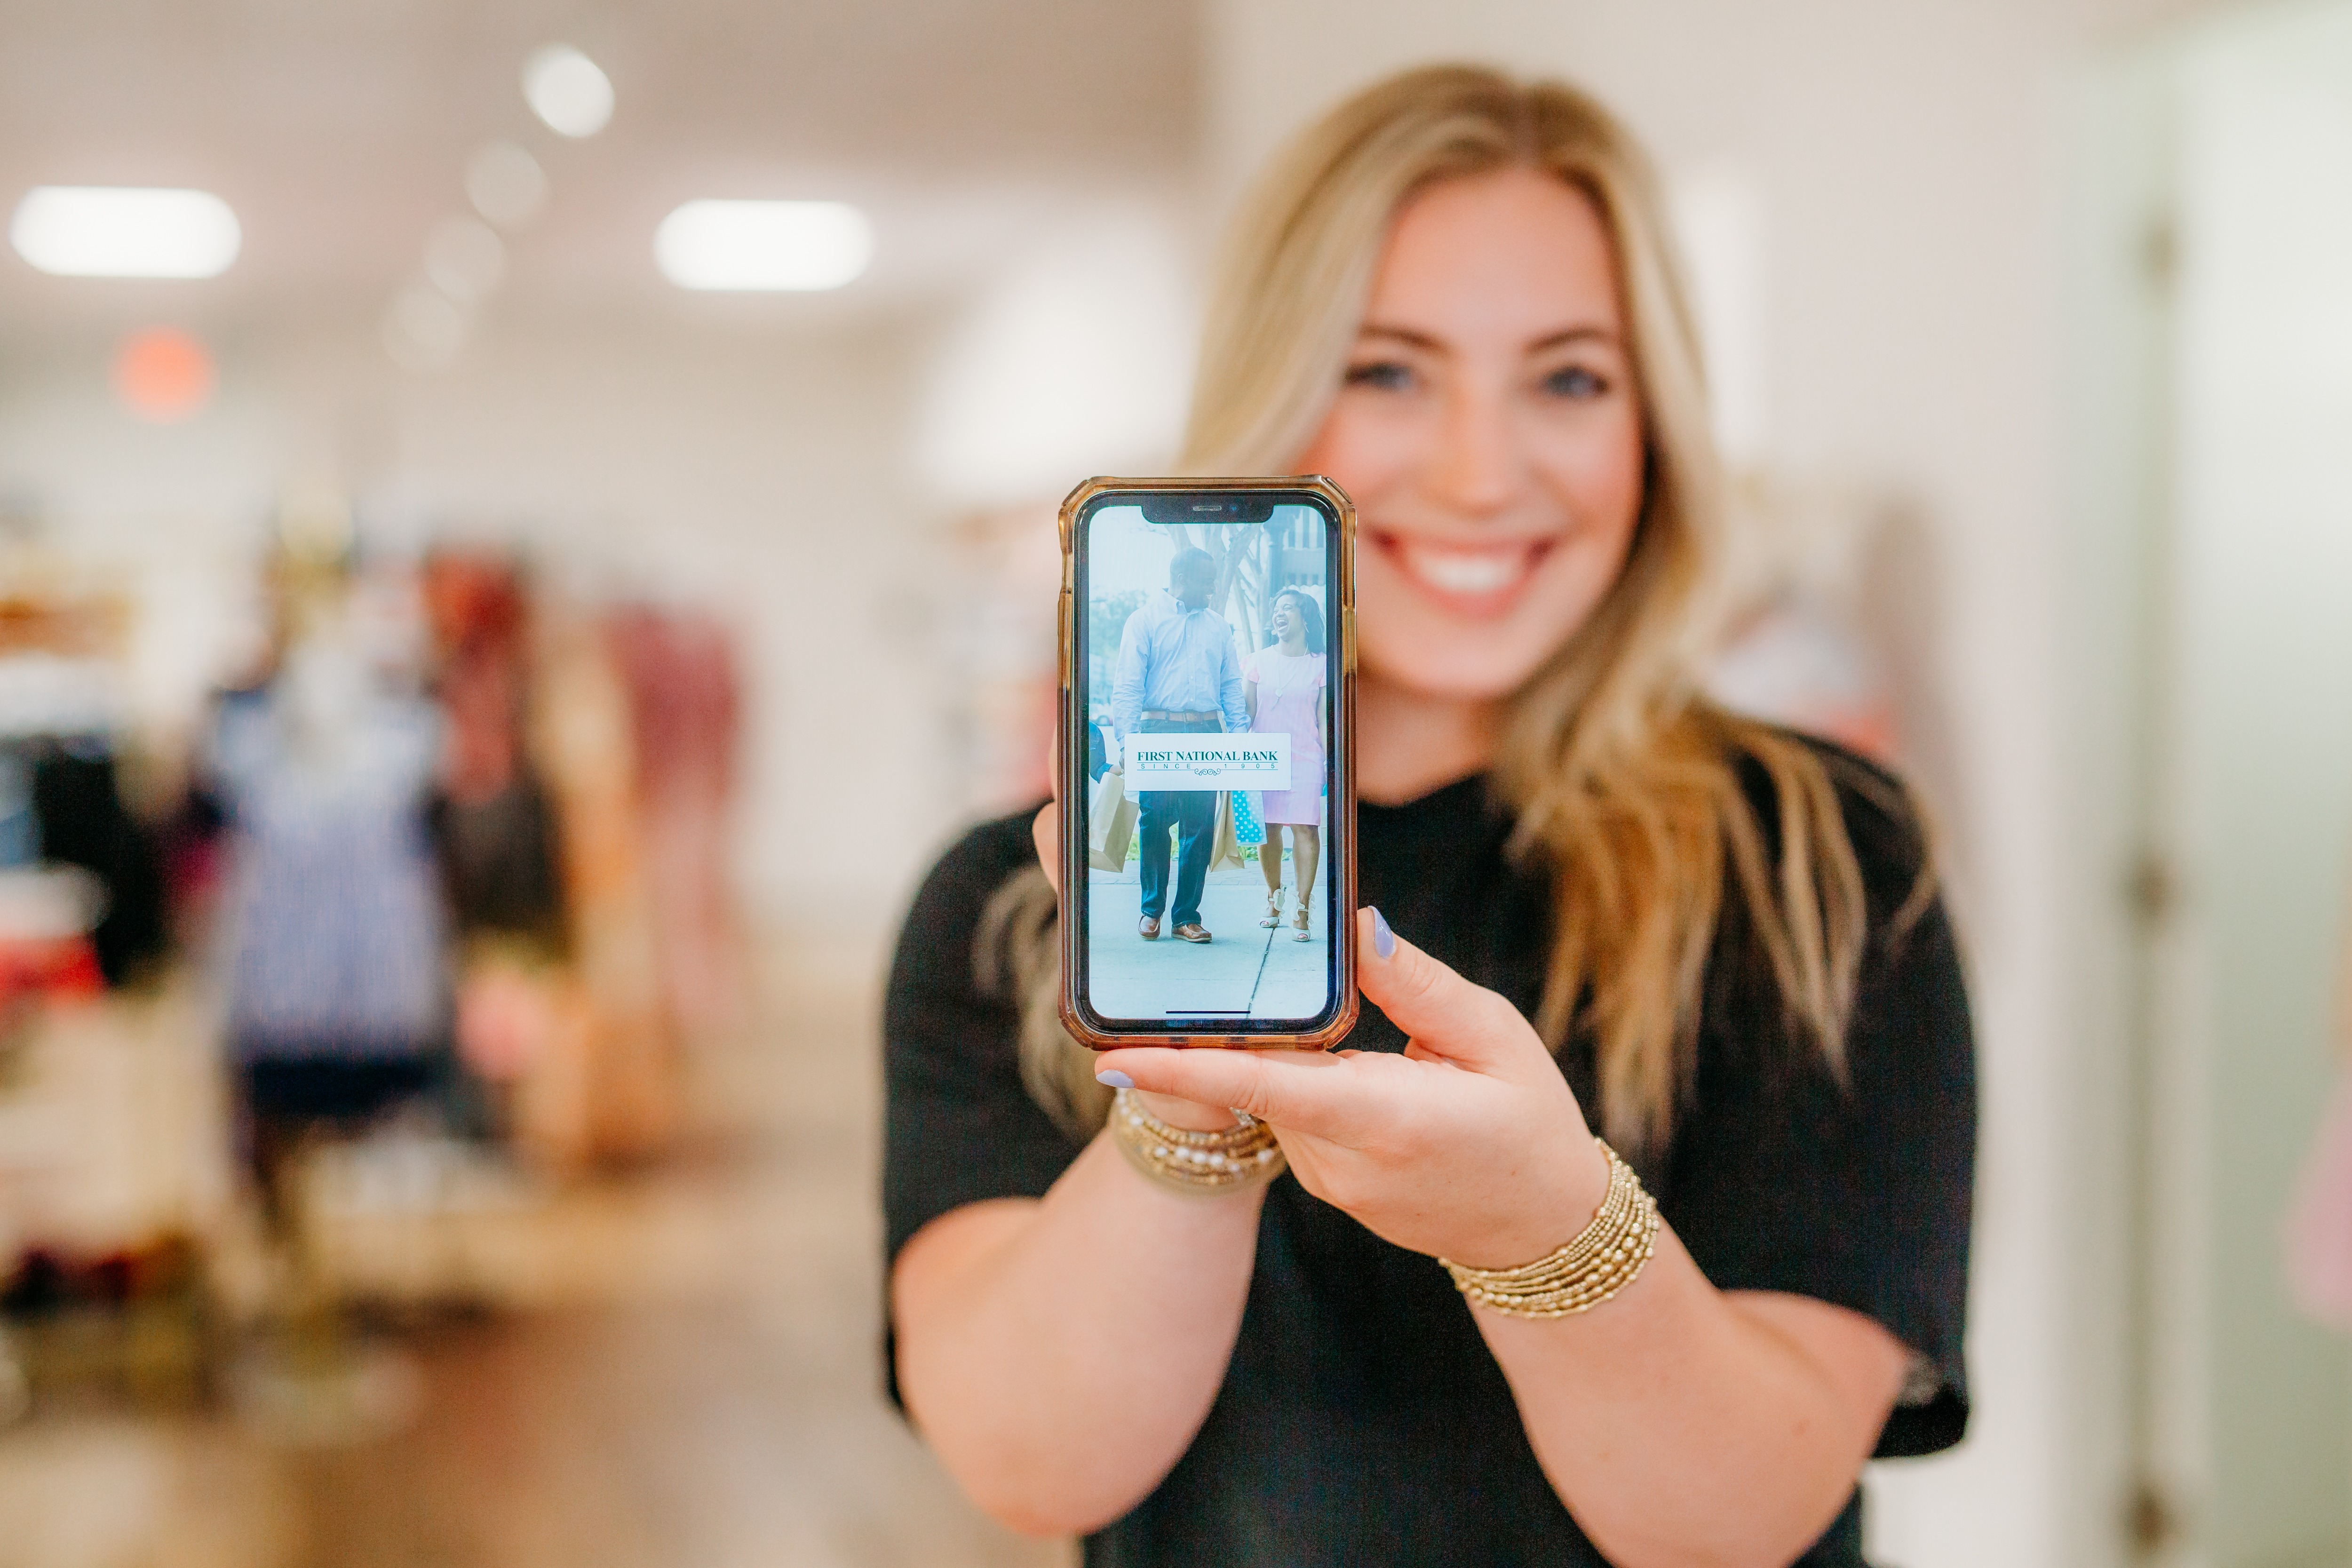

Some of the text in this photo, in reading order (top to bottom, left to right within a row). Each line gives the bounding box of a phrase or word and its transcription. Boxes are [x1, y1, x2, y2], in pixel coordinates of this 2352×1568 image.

[1137, 751, 1278, 761] FIRST NATIONAL BANK
